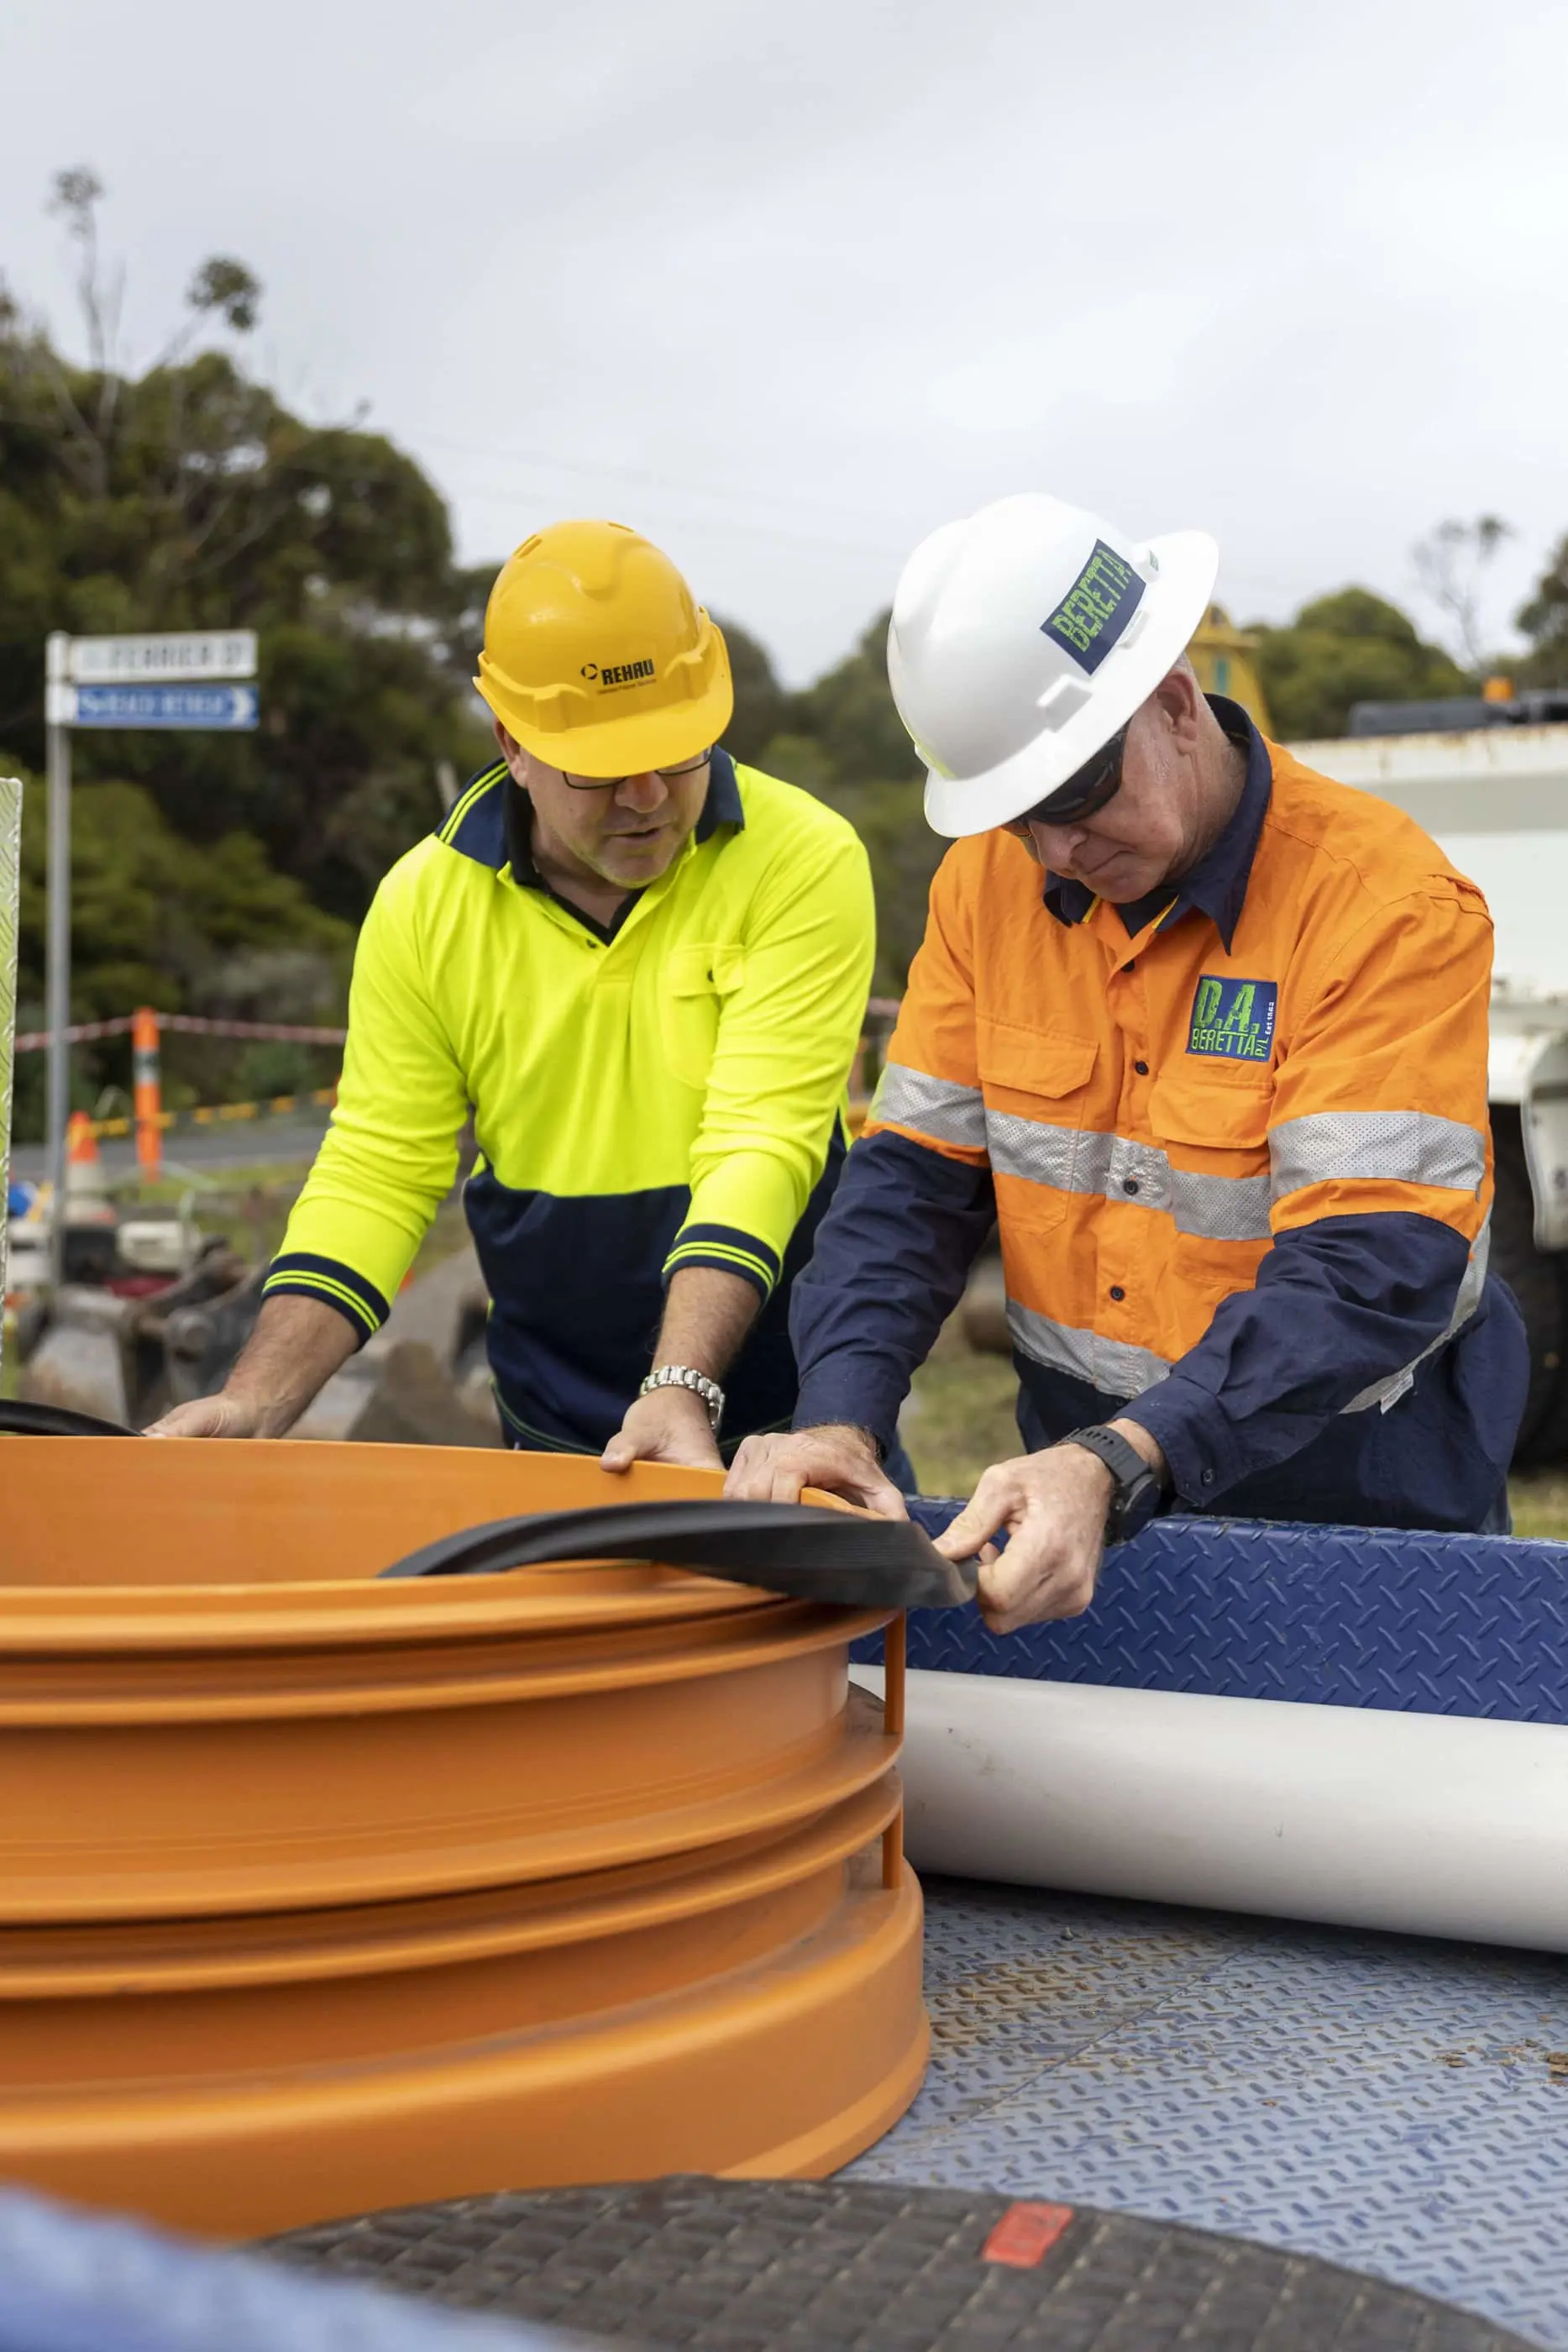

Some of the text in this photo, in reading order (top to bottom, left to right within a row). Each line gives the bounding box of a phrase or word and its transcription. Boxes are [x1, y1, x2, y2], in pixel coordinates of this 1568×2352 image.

[1051, 549, 1132, 652] BERETTA
[600, 659, 654, 685] REHAU
[1194, 979, 1260, 1034] D.A.
[1191, 1028, 1256, 1056] BERETTA
[1255, 1038, 1269, 1057] P/L
